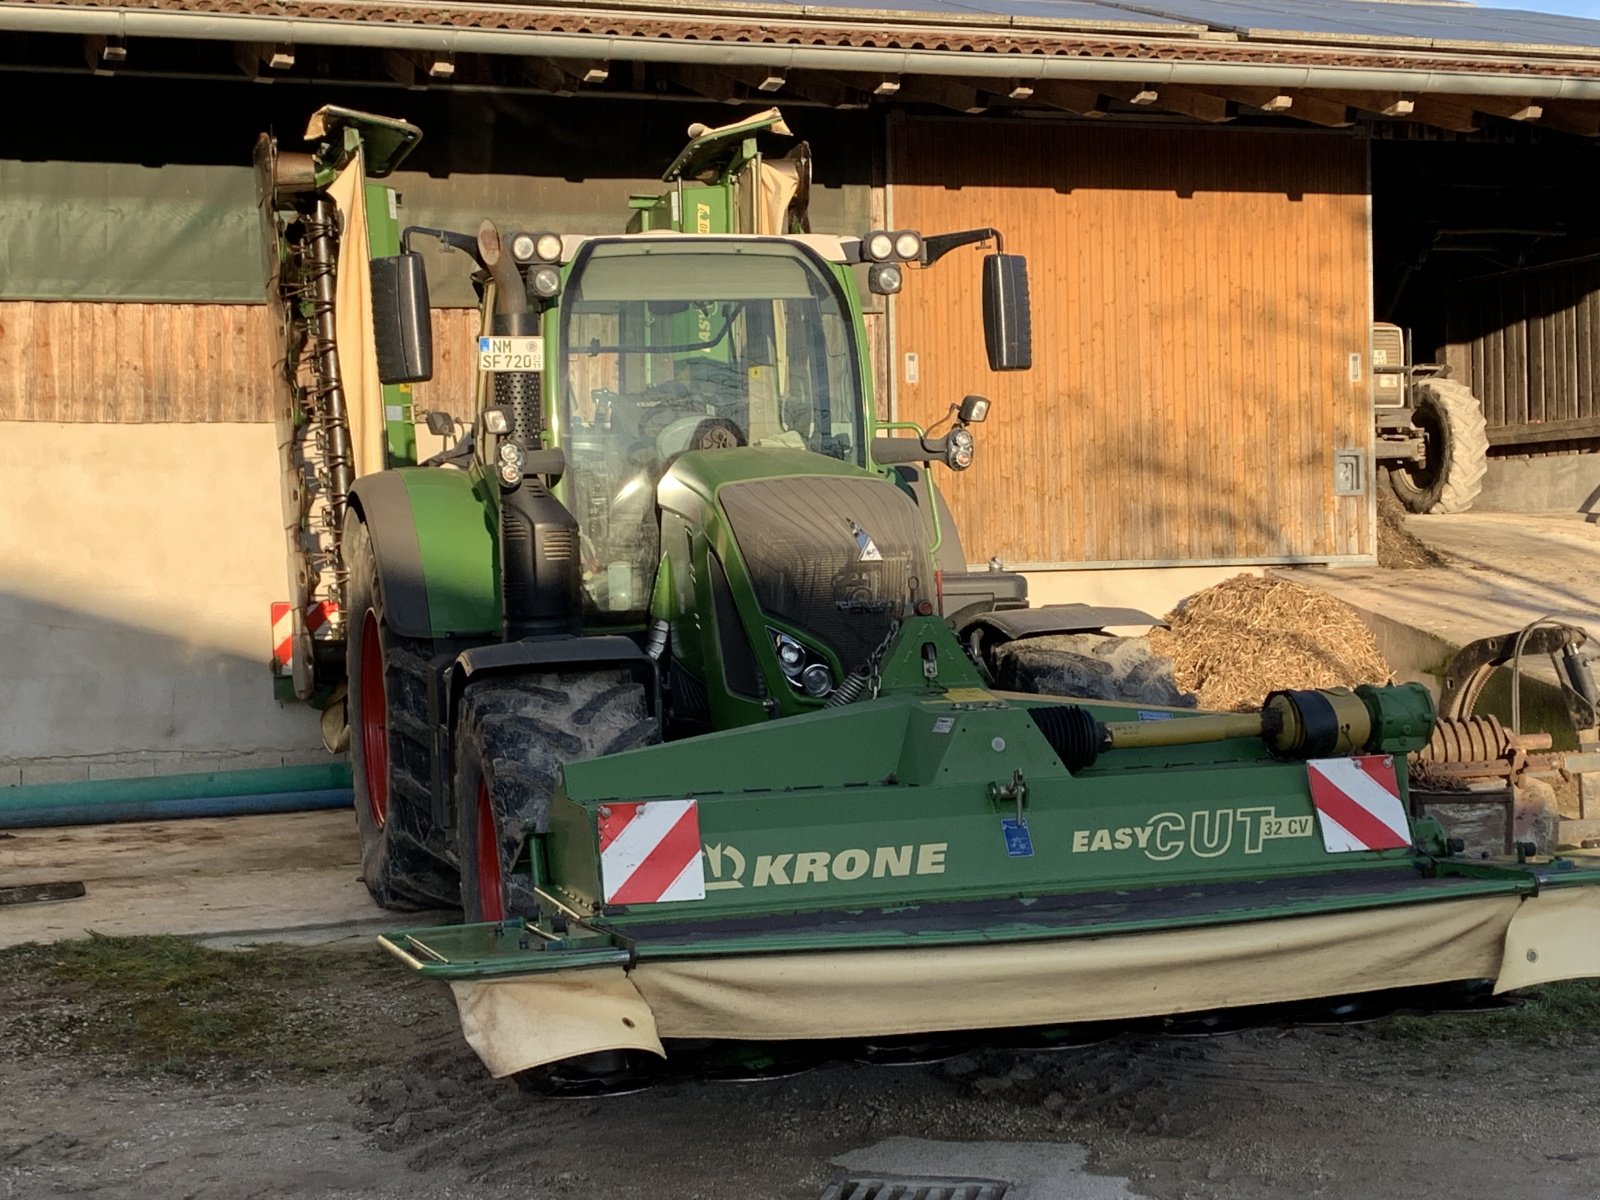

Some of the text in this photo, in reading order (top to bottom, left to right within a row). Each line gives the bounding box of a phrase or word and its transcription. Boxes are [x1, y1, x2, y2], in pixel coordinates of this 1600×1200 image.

[493, 340, 511, 353] NM
[483, 355, 531, 368] SF 720
[1263, 820, 1283, 836] 32
[1287, 818, 1310, 835] CV
[752, 842, 949, 888] KRONE
